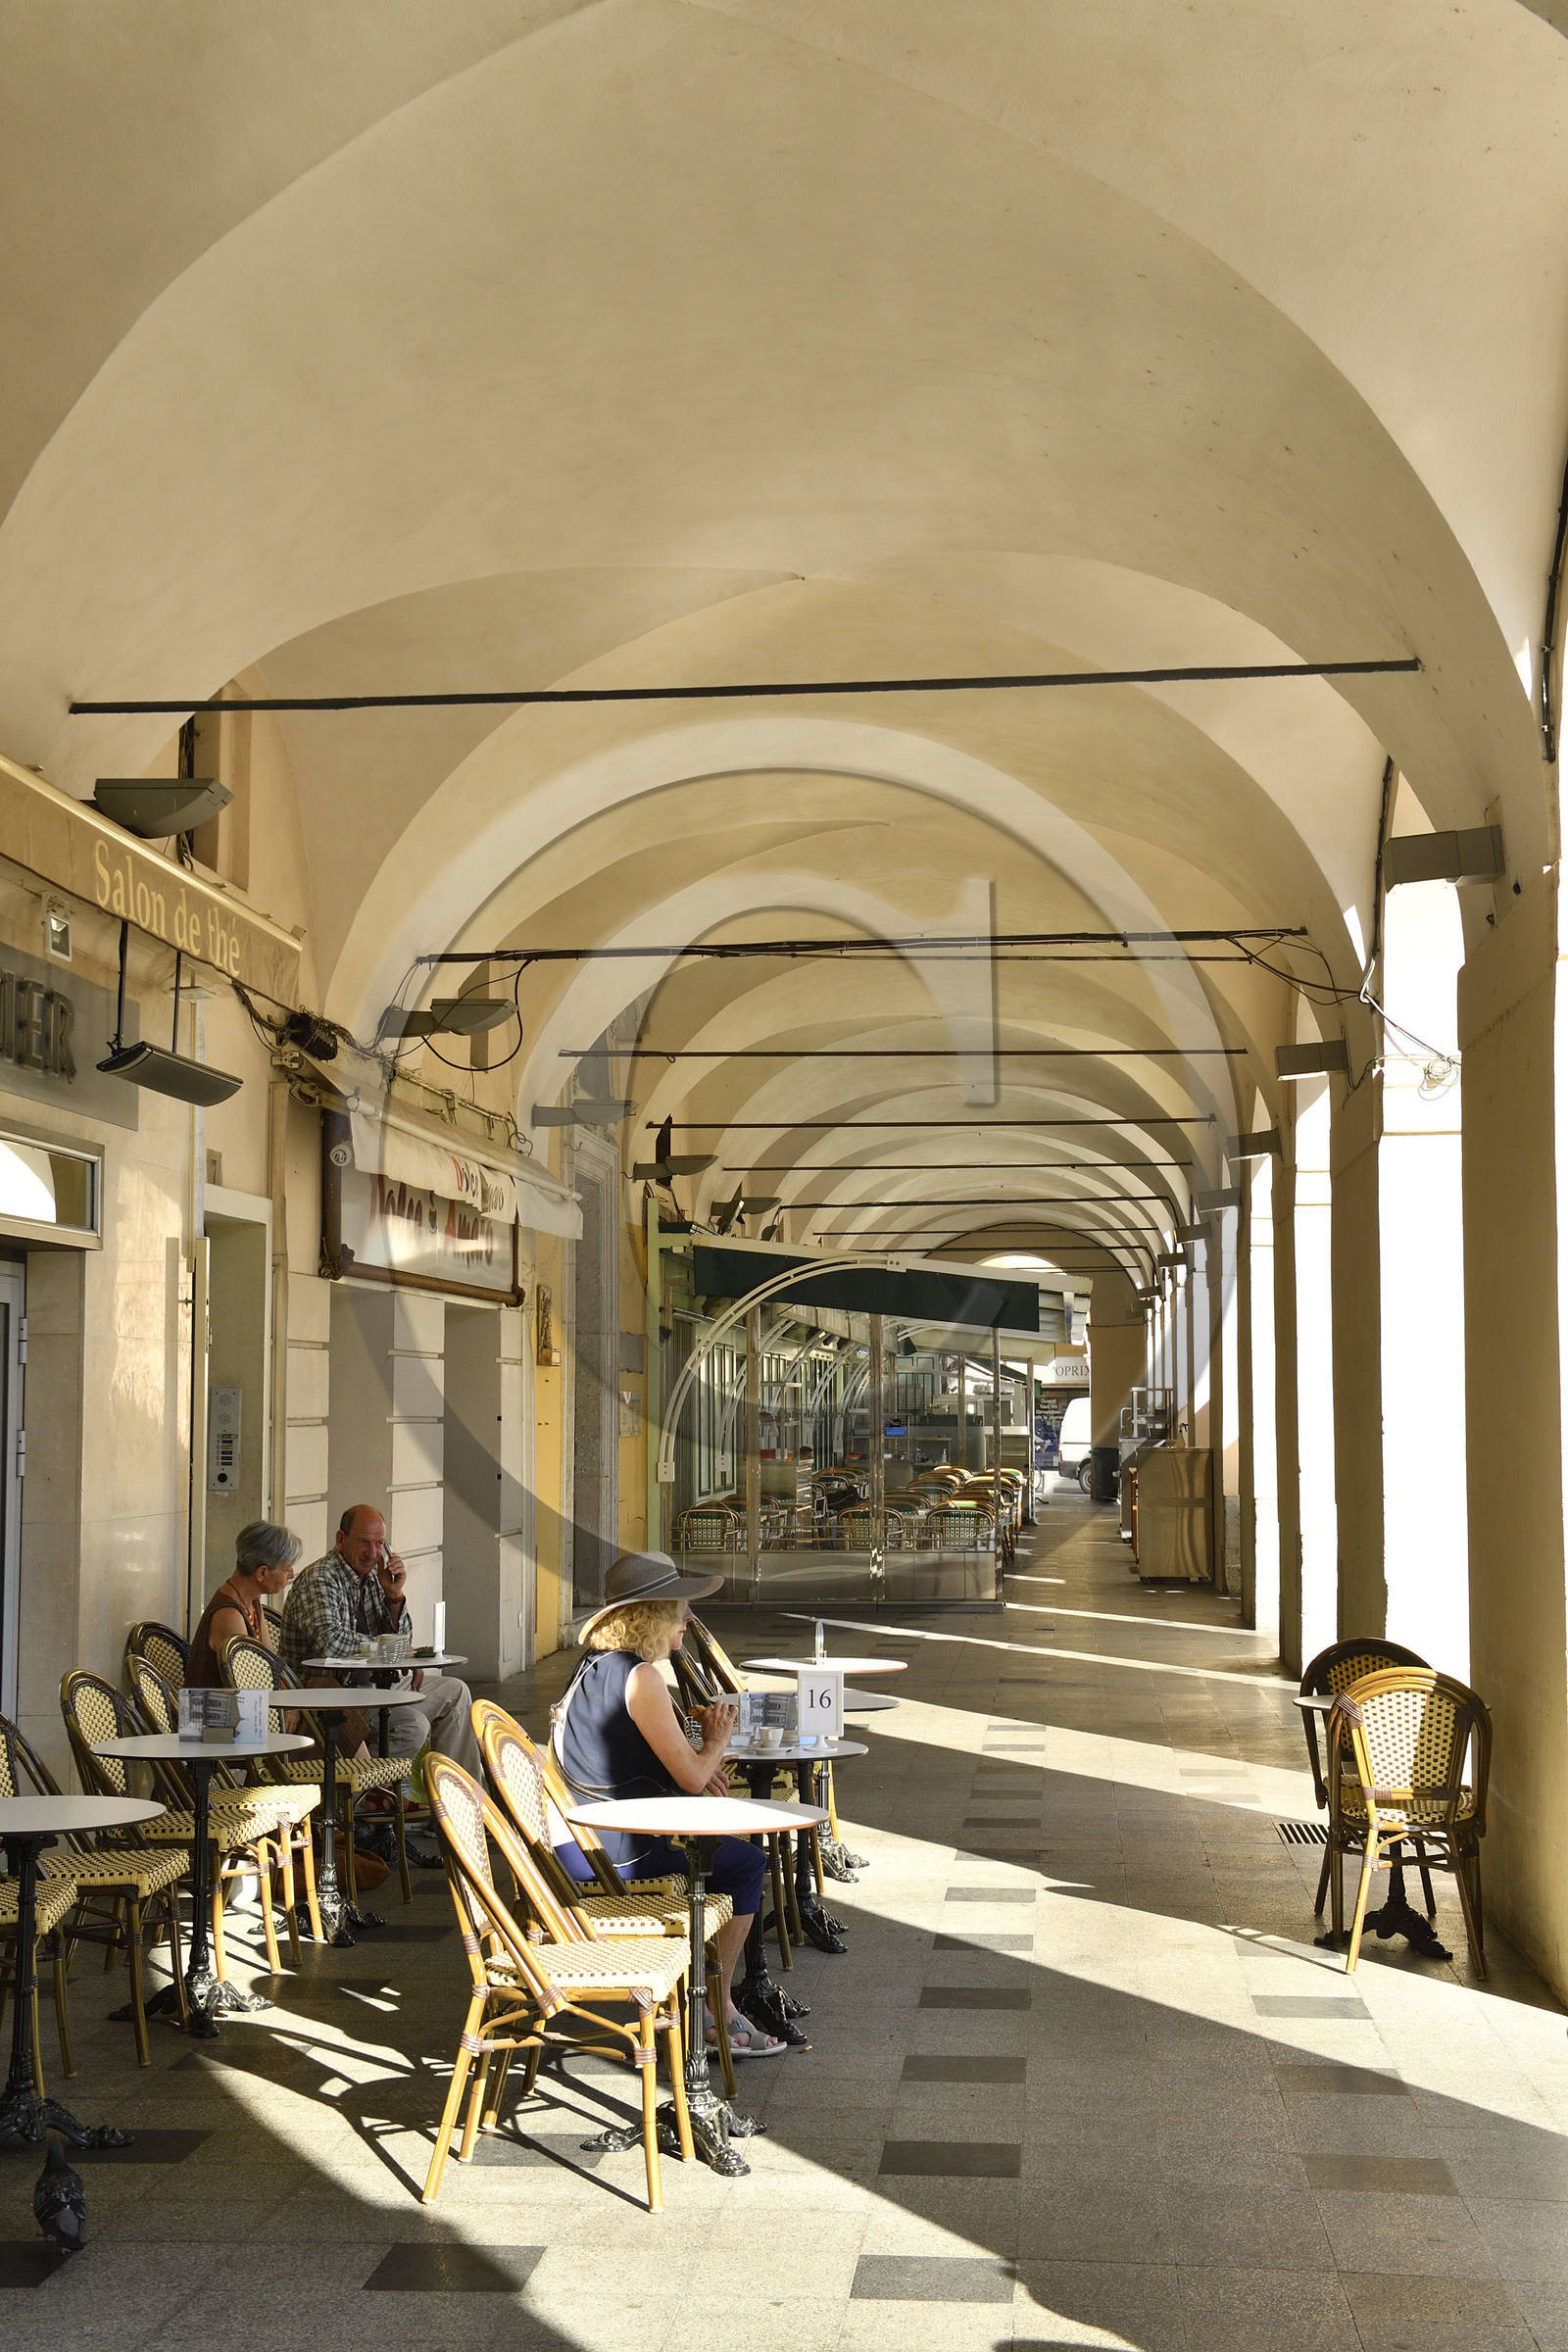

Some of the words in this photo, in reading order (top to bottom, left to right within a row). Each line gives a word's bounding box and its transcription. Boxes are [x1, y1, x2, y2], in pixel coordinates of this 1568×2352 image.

[95, 839, 168, 940] Salon
[174, 888, 201, 956] de
[208, 906, 240, 978] thé
[808, 1689, 832, 1709] 16
